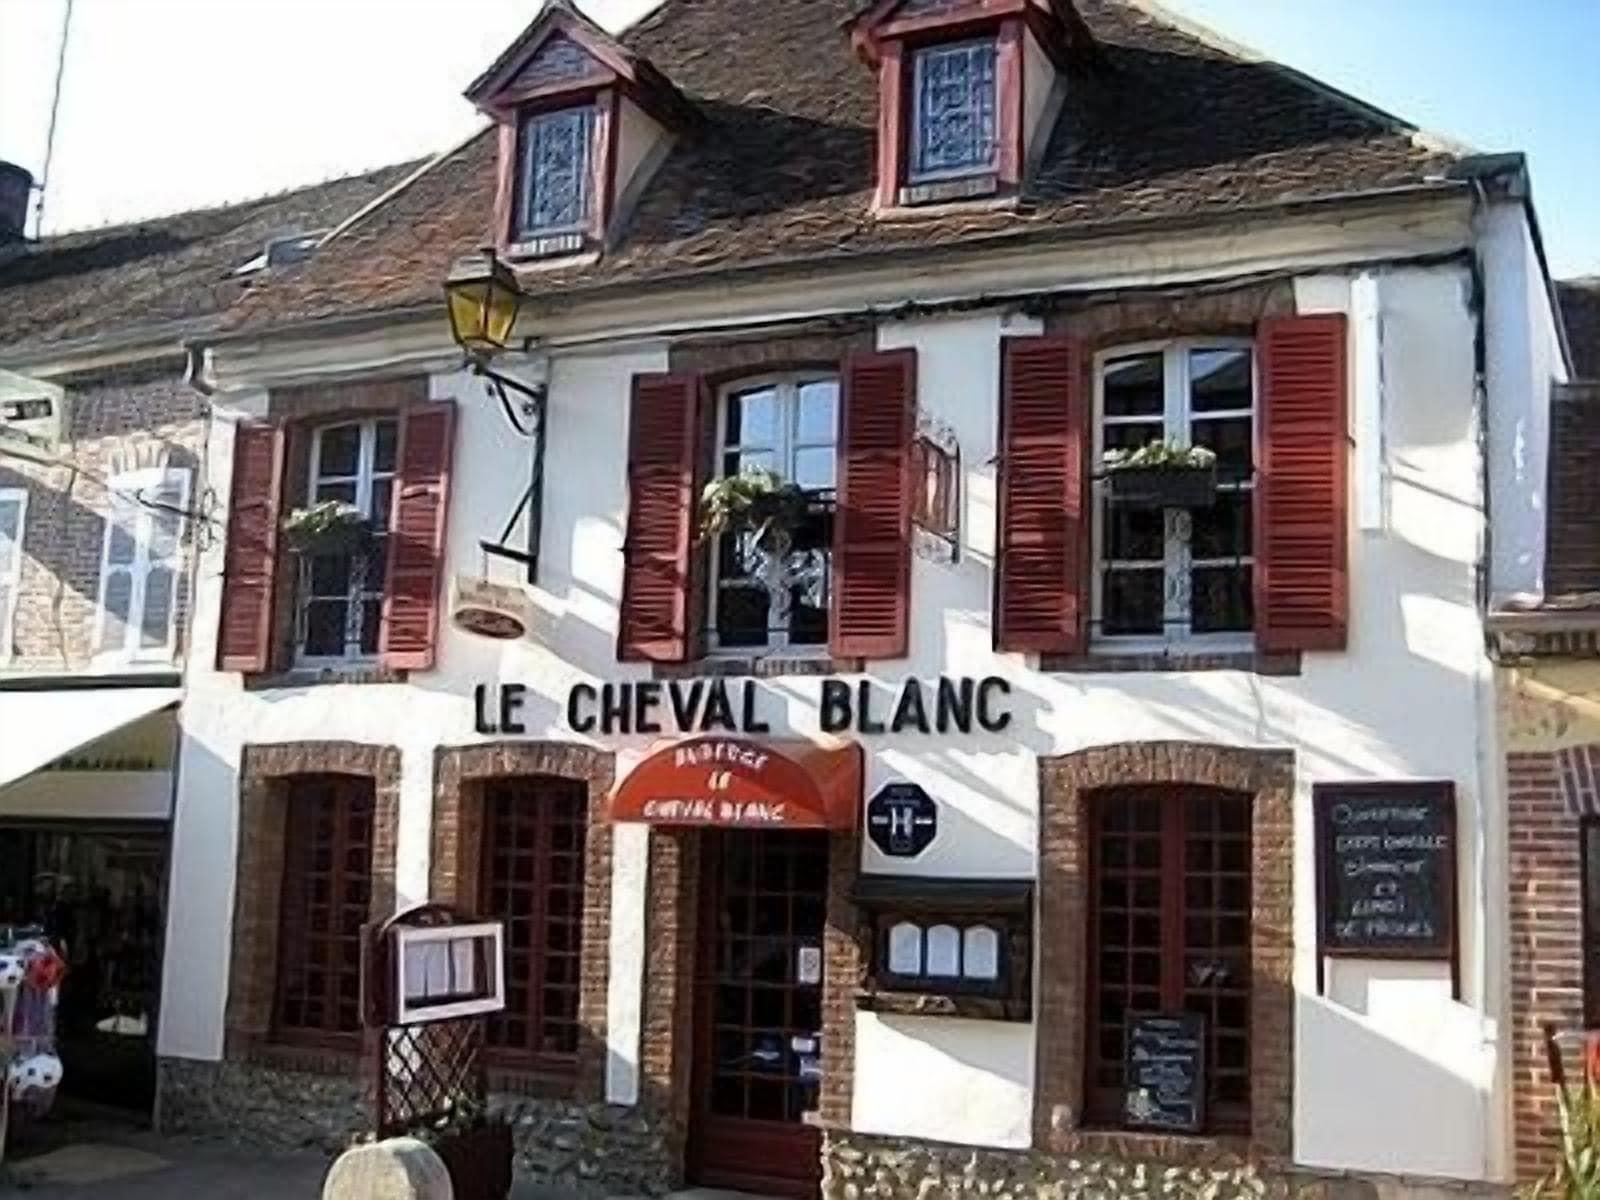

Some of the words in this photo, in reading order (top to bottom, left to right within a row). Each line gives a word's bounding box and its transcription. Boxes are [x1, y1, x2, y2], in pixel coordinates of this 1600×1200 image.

[474, 683, 526, 734] LE
[567, 680, 770, 734] CHEVAL
[820, 676, 1011, 733] BLANC
